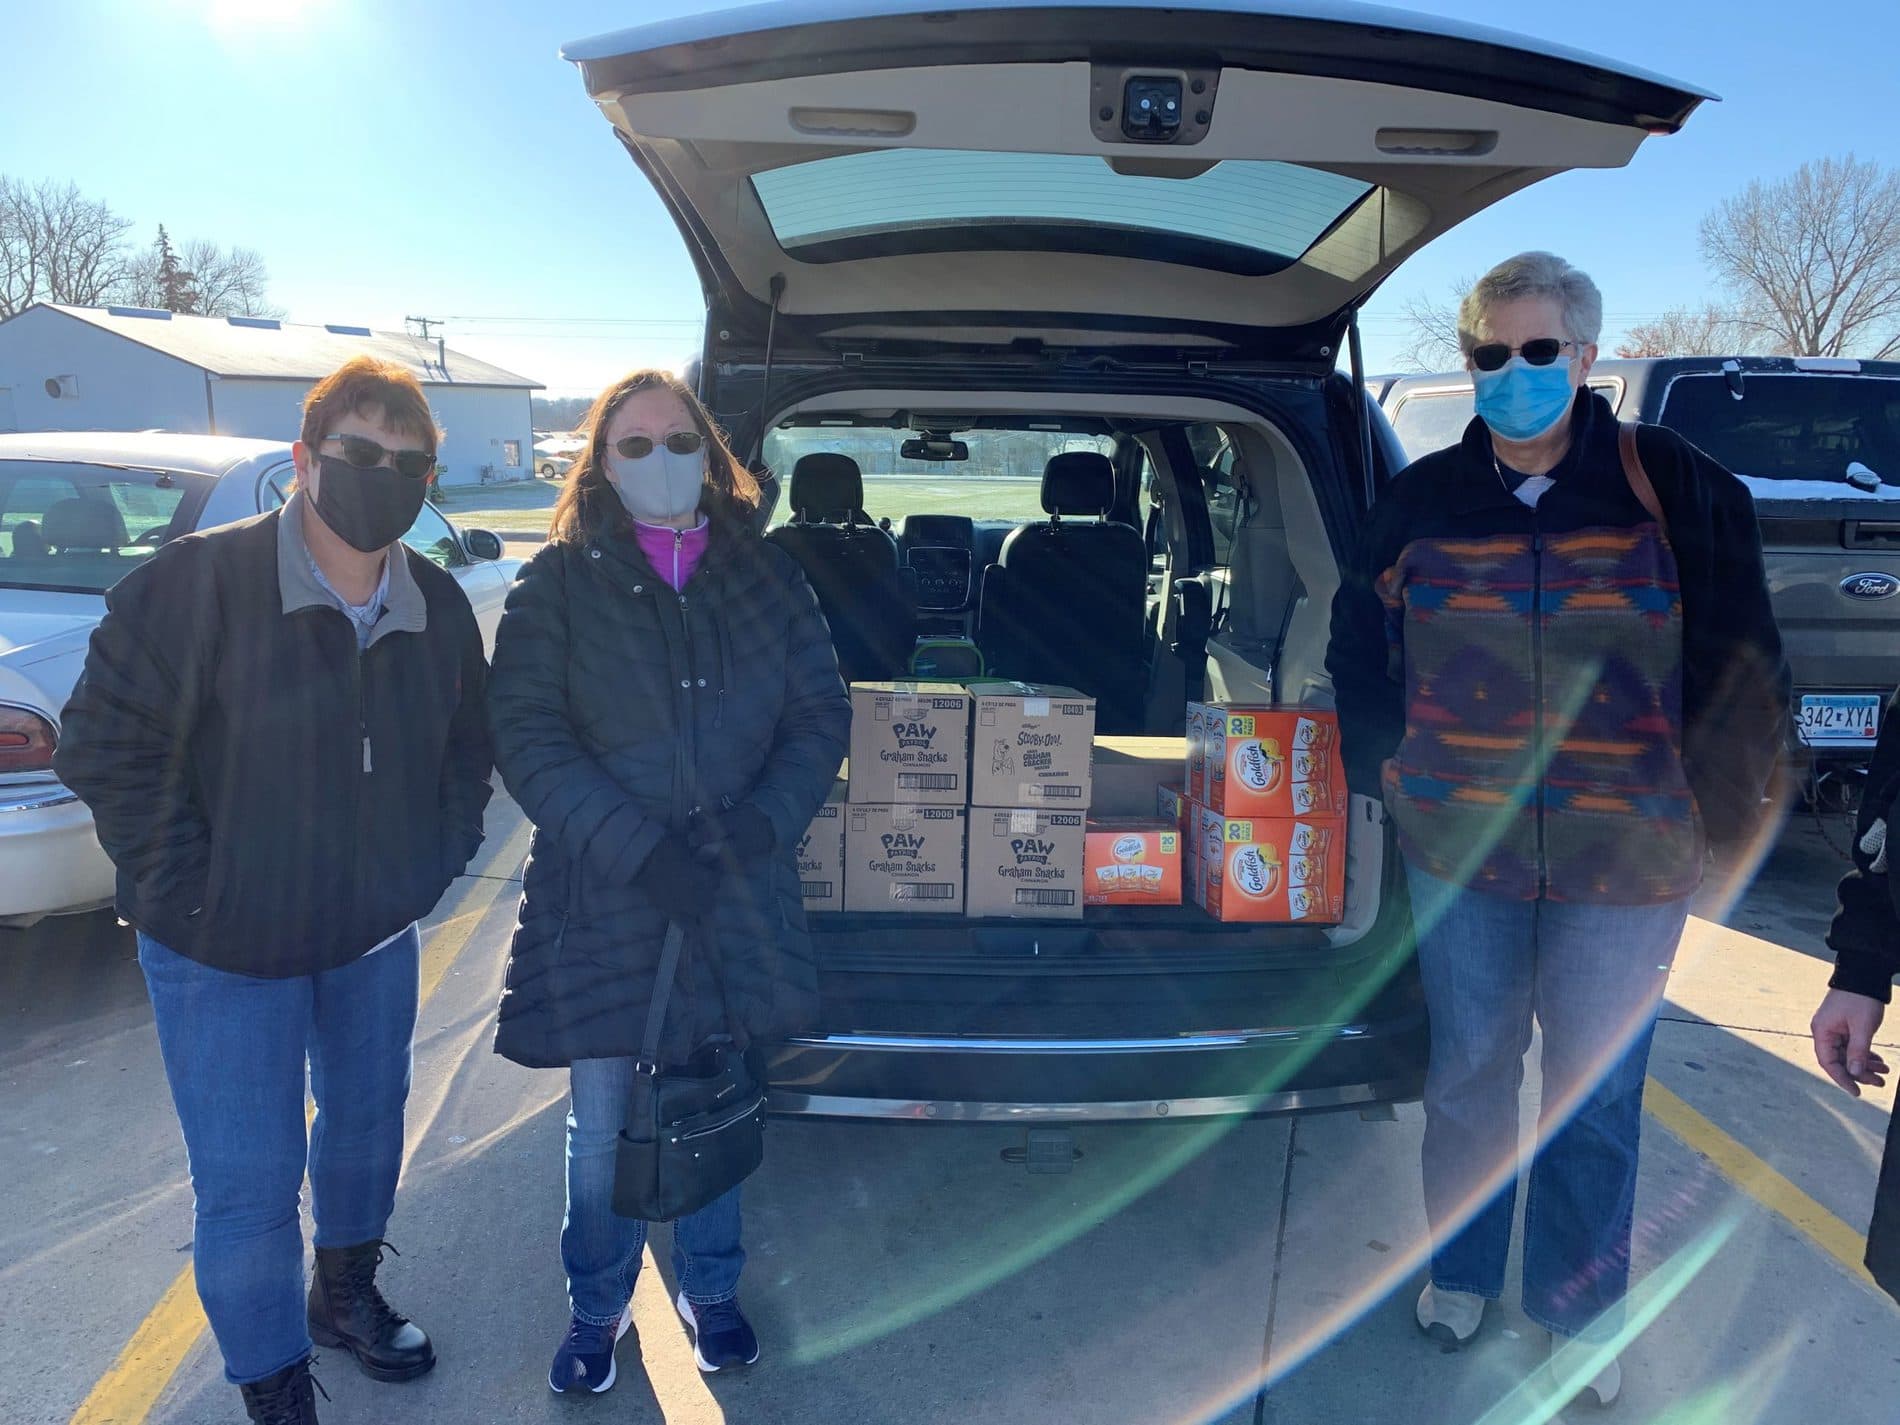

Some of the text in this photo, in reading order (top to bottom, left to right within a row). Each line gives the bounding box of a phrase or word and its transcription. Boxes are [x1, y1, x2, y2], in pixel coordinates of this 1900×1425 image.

[1855, 578, 1890, 594] Ford
[934, 699, 962, 709] 12006
[1804, 706, 1873, 727] 342 XYA
[892, 722, 937, 739] PAW
[1231, 717, 1243, 735] 20
[880, 749, 948, 763] Graham Snacks
[1245, 745, 1266, 786] Goldfish
[925, 809, 953, 819] 12006
[1051, 815, 1080, 825] 12006
[1229, 823, 1241, 840] 20
[881, 833, 925, 849] PAW
[1011, 838, 1055, 855] PAW
[1161, 836, 1175, 845] 20
[869, 860, 936, 873] Graham Snacks
[998, 865, 1065, 879] Graham Snacks
[1244, 851, 1264, 891] Goldfish
